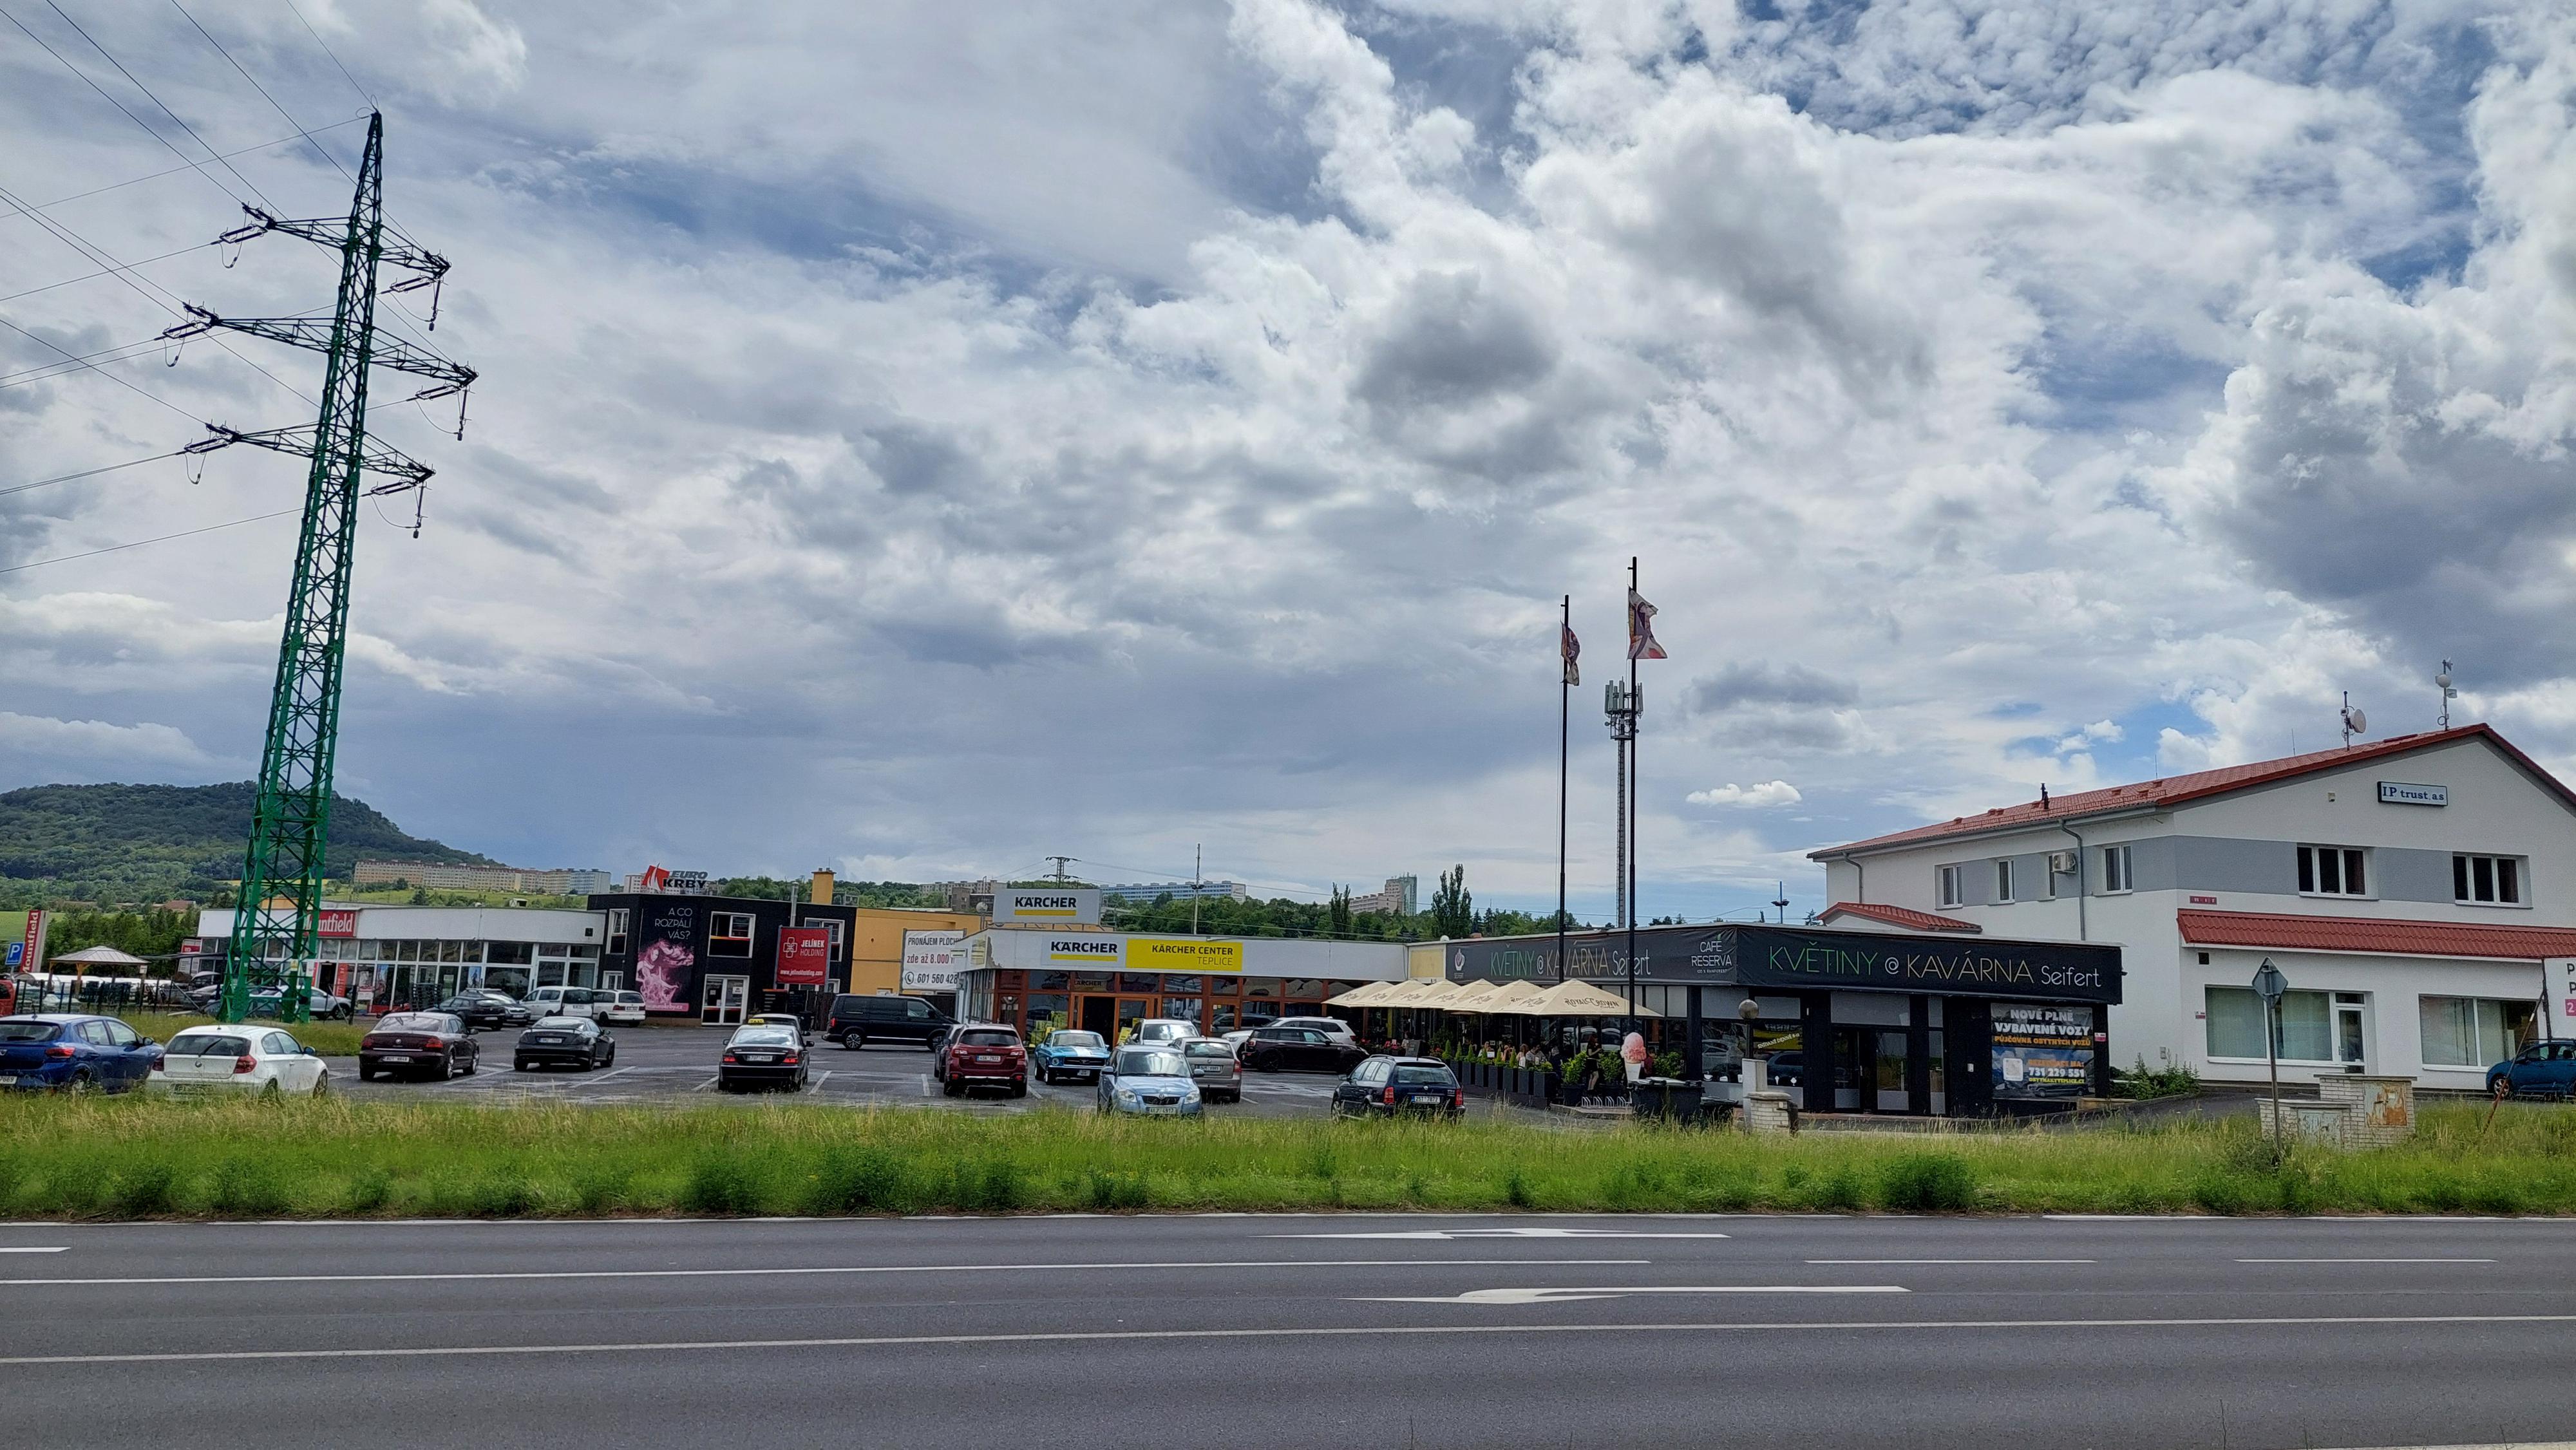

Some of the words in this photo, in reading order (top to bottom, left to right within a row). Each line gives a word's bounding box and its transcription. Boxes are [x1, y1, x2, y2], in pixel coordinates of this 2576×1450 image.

[671, 871, 708, 880] EURO
[663, 878, 706, 889] KRBY
[1015, 896, 1077, 908] KÄRCHER
[668, 907, 676, 916] A
[677, 908, 693, 916] CO
[654, 918, 692, 928] ROZPÁLÍ
[668, 929, 691, 940] VÁS?
[800, 938, 825, 948] JELÍNEK
[908, 936, 938, 946] PRONÁJEM
[10, 945, 21, 958] P
[800, 948, 824, 957] HOLDING
[1050, 941, 1118, 954] KÄRCHER
[1151, 944, 1196, 954] KÄRCHER
[1198, 946, 1233, 956] CENTER
[907, 954, 919, 964] zde
[920, 953, 929, 964] až
[930, 954, 949, 964] 8.000
[1197, 956, 1233, 966] TEPLICE
[1490, 943, 1535, 977] KVĚTINY
[1537, 955, 1544, 975] @
[1612, 948, 1651, 976] Seiert
[1691, 954, 1732, 966] RESERVA
[1770, 941, 1878, 975] KVĚTINY
[1884, 957, 1899, 975] @
[1908, 950, 2034, 984] KAVÁRNA
[2041, 966, 2102, 988] Seifert
[917, 973, 930, 984] 601
[931, 974, 945, 984] 560
[945, 974, 958, 984] 428
[2010, 1008, 2042, 1020] NOVÉ
[2045, 1010, 2074, 1022] PLNĚ
[1994, 1022, 2056, 1035] VYBAVENÉ
[2057, 1026, 2090, 1036] VOZY
[2029, 1067, 2045, 1077] 731
[2047, 1068, 2066, 1077] 229
[2068, 1068, 2085, 1078] 551
